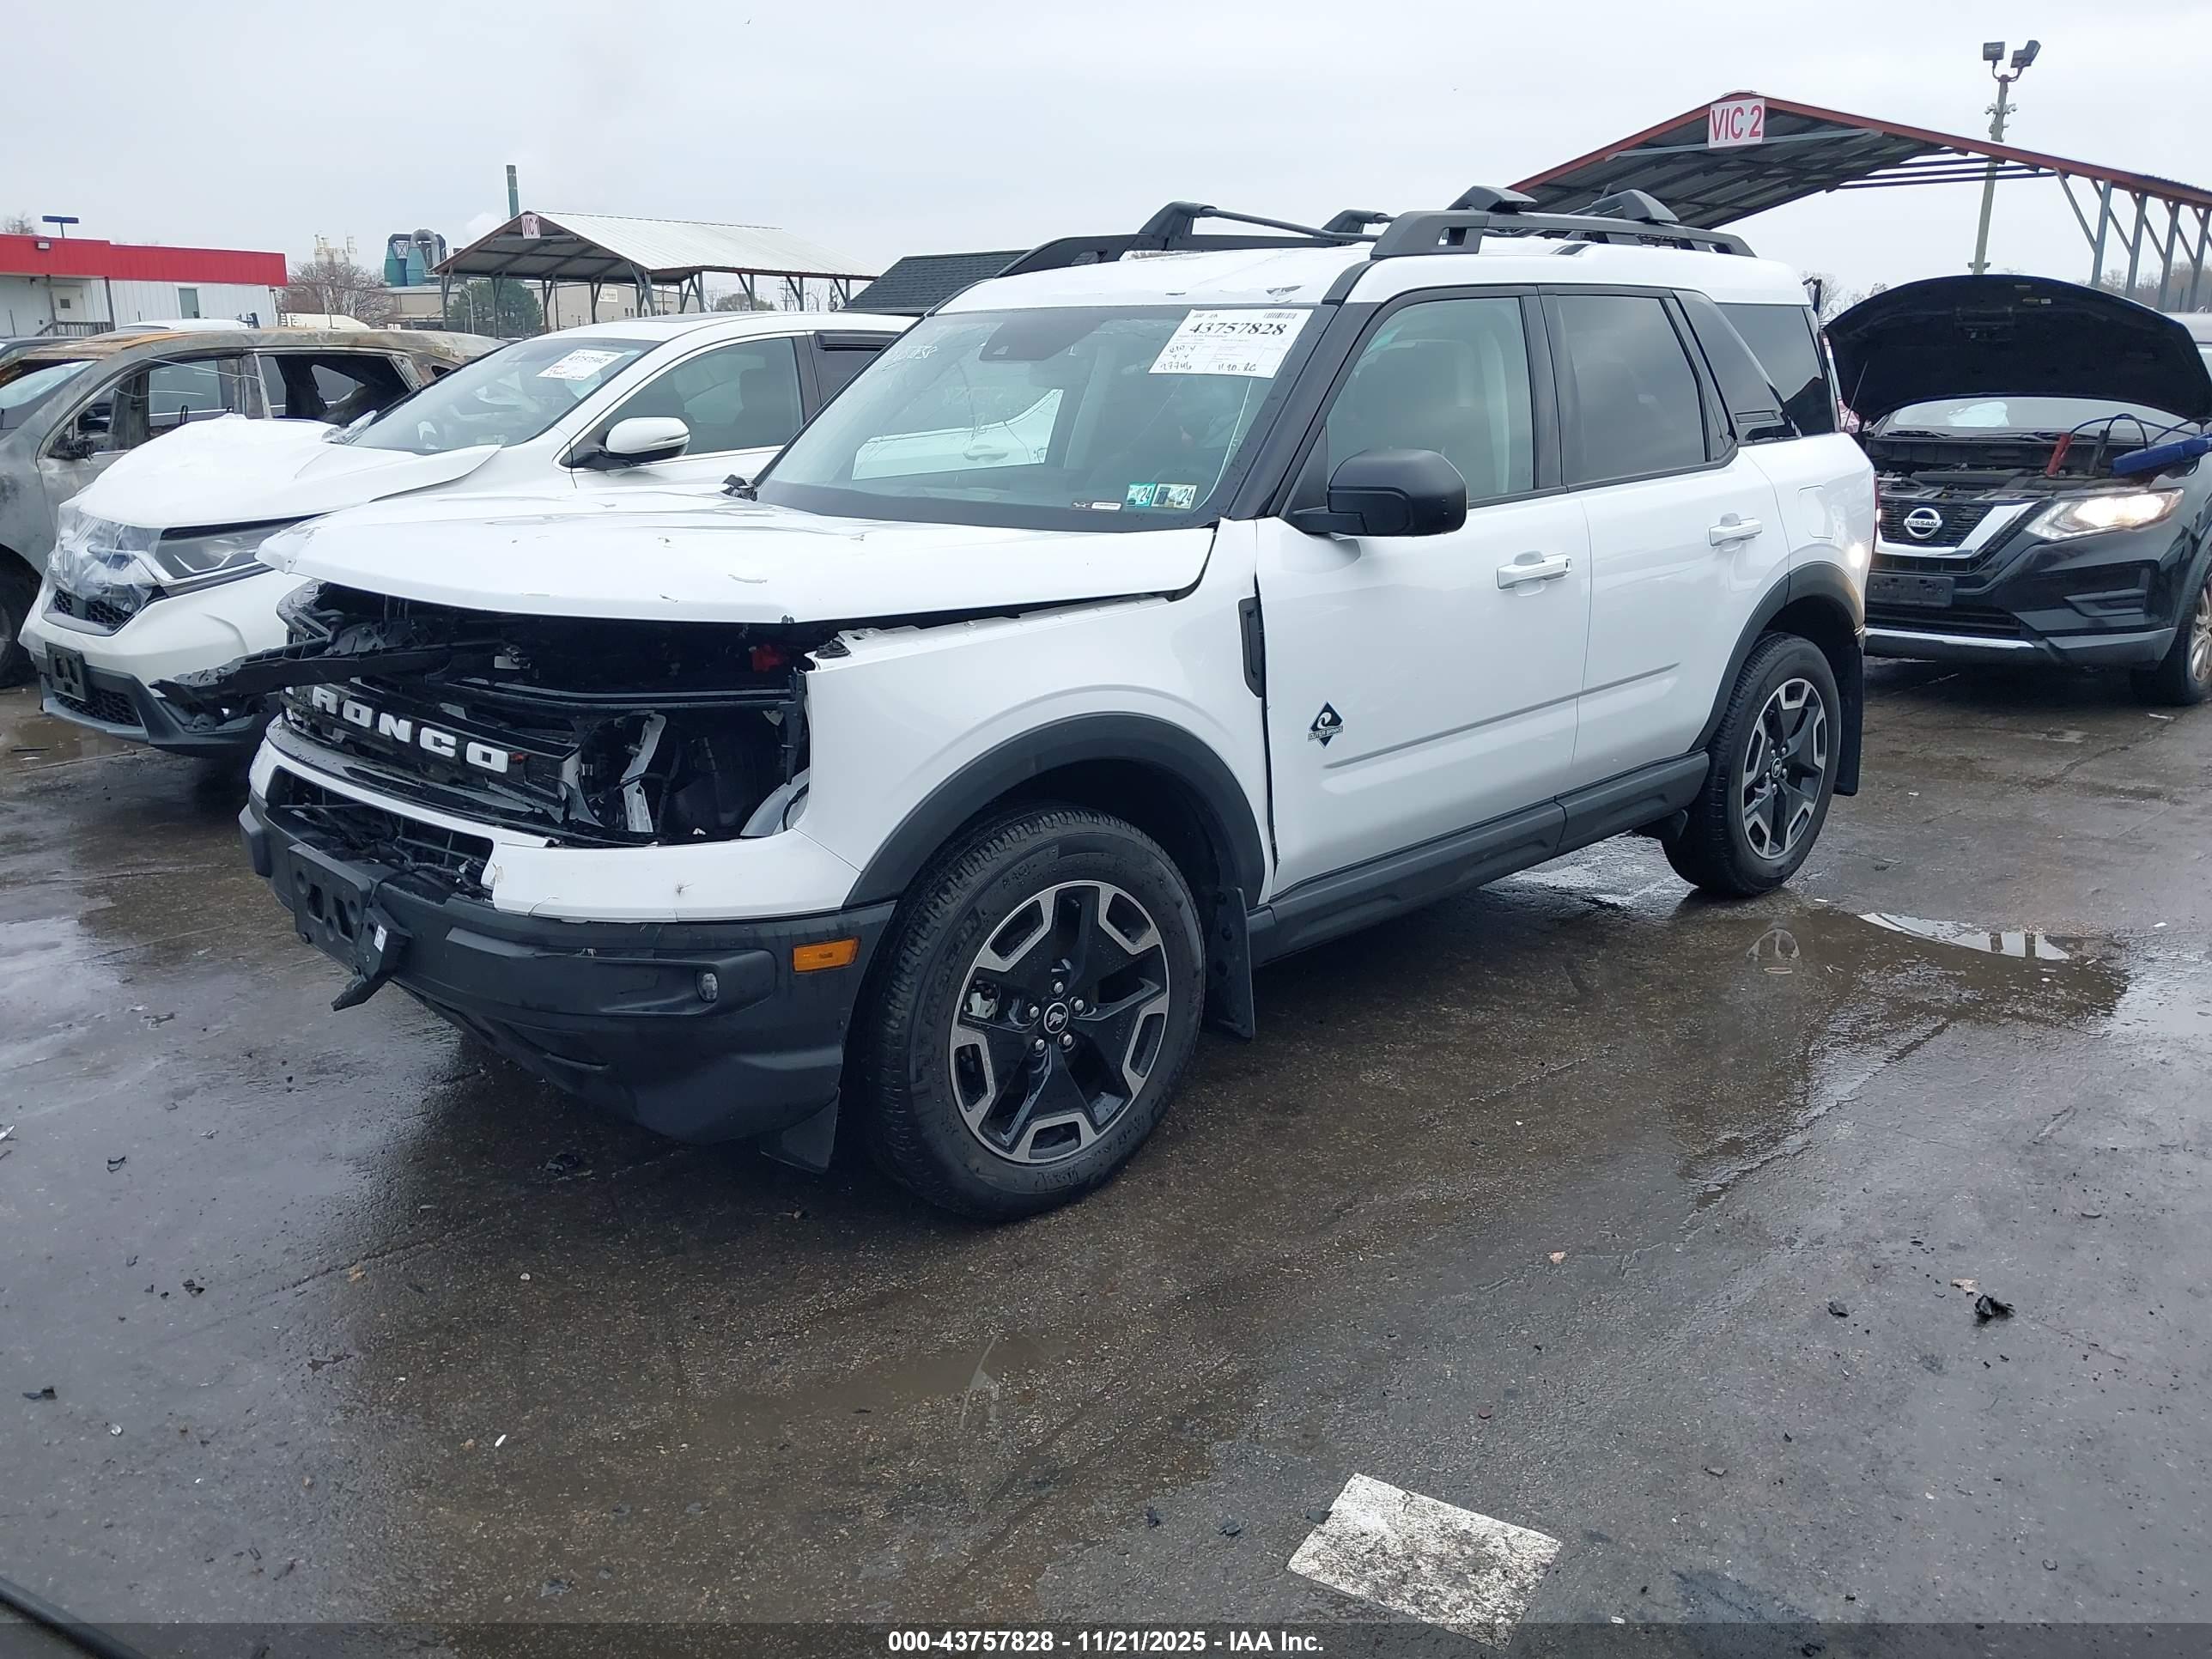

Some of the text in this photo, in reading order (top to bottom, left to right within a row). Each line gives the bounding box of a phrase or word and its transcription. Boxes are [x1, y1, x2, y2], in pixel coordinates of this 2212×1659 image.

[1711, 105, 1763, 142] VIC 2
[521, 217, 540, 235] VIC 1
[1188, 322, 1288, 336] 43757828
[284, 685, 509, 774] RONCO
